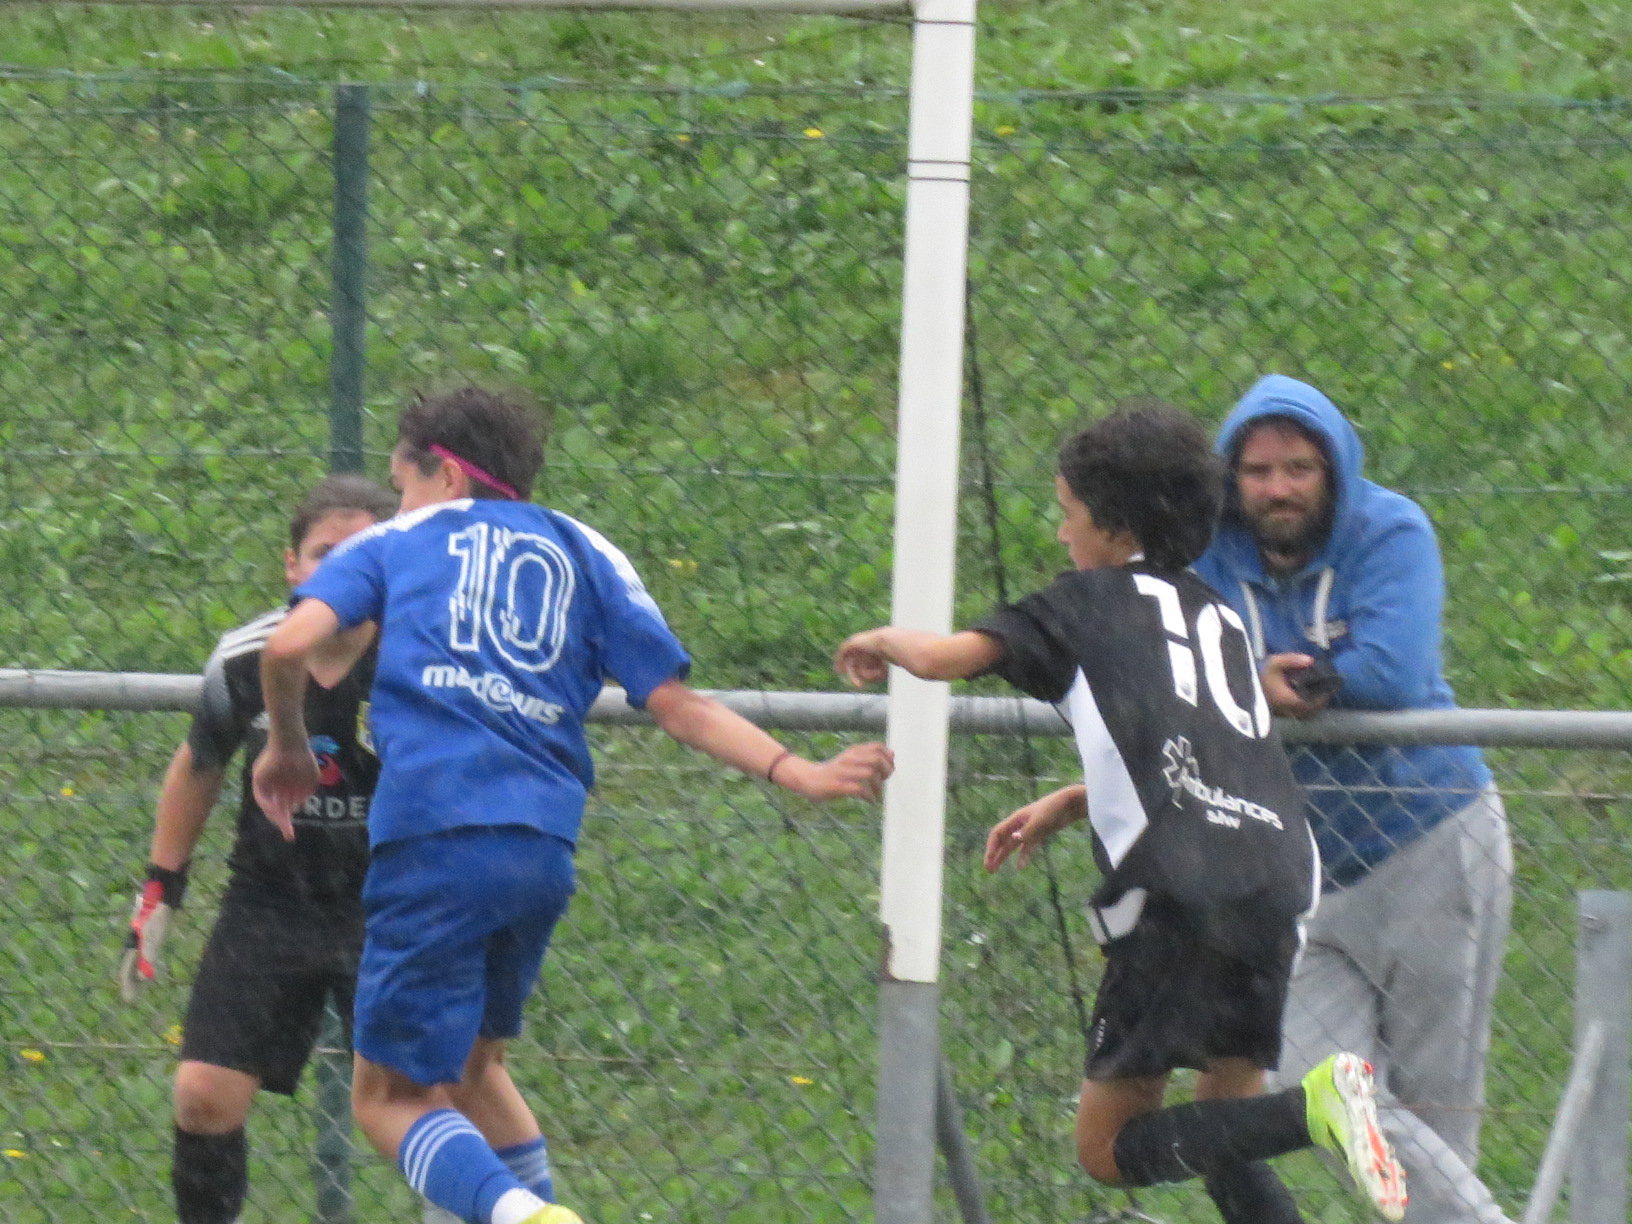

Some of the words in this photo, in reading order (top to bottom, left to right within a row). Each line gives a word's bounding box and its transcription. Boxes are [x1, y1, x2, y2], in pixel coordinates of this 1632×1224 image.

[448, 521, 576, 673] 10
[1132, 572, 1271, 739] 10
[291, 794, 367, 819] RDE
